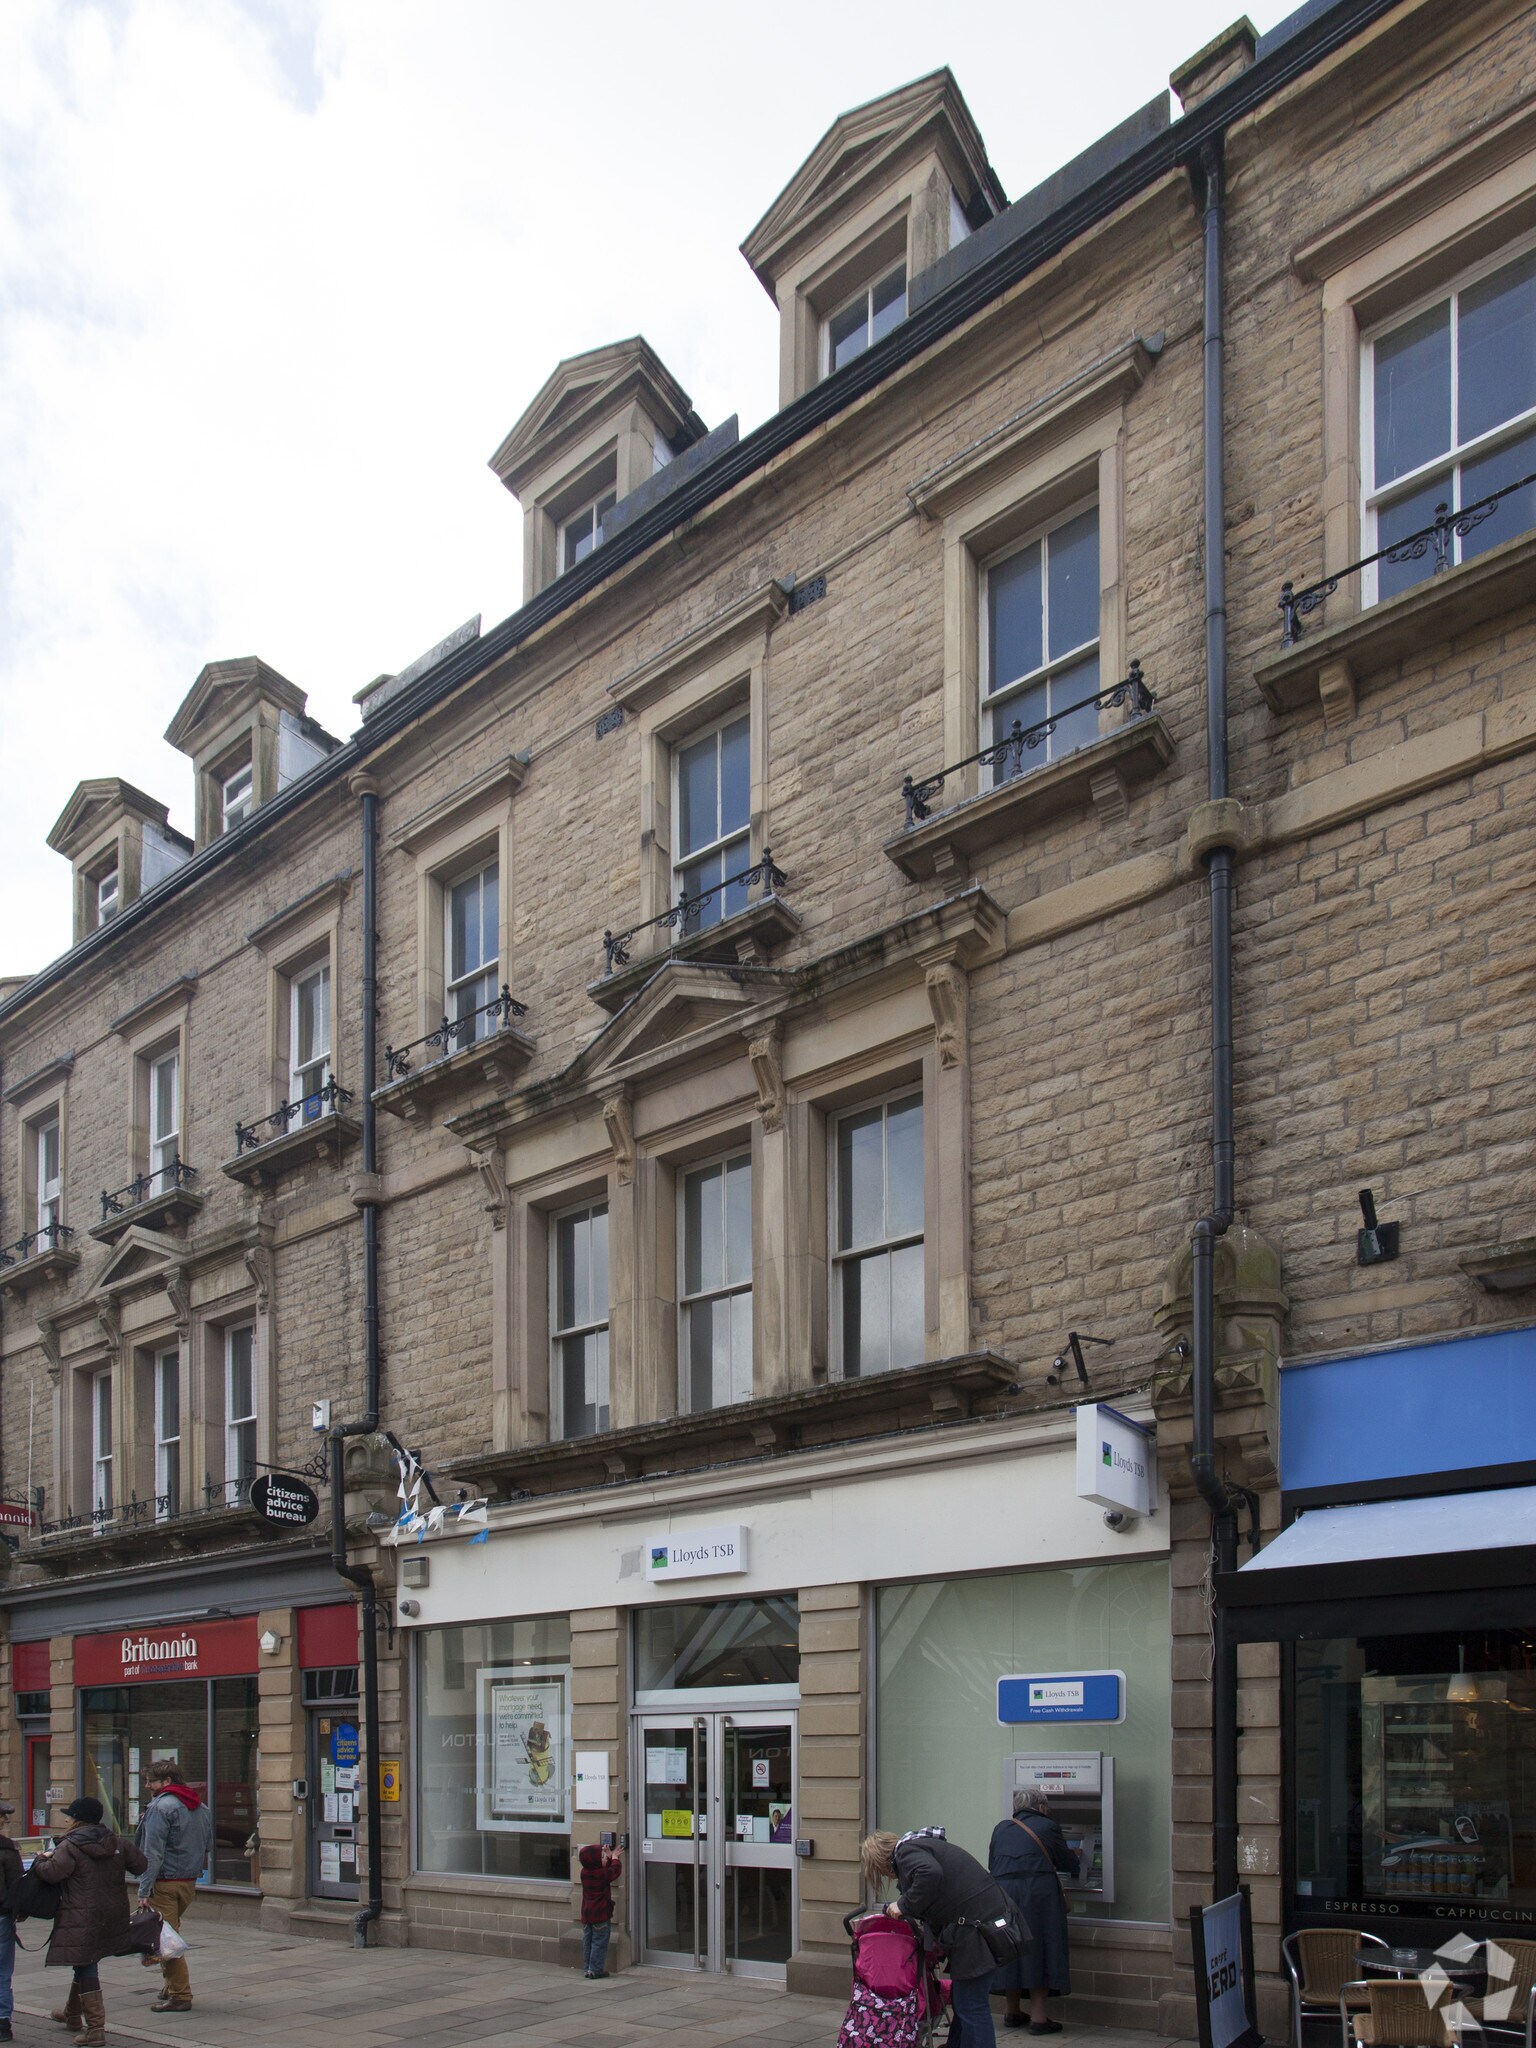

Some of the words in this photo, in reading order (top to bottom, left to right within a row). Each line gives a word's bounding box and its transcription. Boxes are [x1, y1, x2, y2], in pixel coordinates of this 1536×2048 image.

[1114, 1450, 1133, 1474] Lloyds
[1133, 1461, 1145, 1478] TSB
[266, 1486, 310, 1503] citizens
[266, 1497, 304, 1512] advice
[266, 1505, 307, 1523] bureau
[673, 1546, 709, 1565] Lloyds
[712, 1543, 734, 1558] TSB
[121, 1632, 198, 1663] Britannia
[124, 1665, 135, 1677] part
[134, 1664, 140, 1675] of
[184, 1659, 198, 1671] bank
[526, 1694, 539, 1702] your
[1045, 1690, 1066, 1698] Lloyds
[1067, 1689, 1080, 1697] TSB
[499, 1704, 526, 1712] mortgage
[514, 1711, 544, 1720] committed
[499, 1721, 504, 1729] to
[1325, 1900, 1399, 1914] ESPRESSO
[1435, 1906, 1533, 1922] CAPPUCCIN
